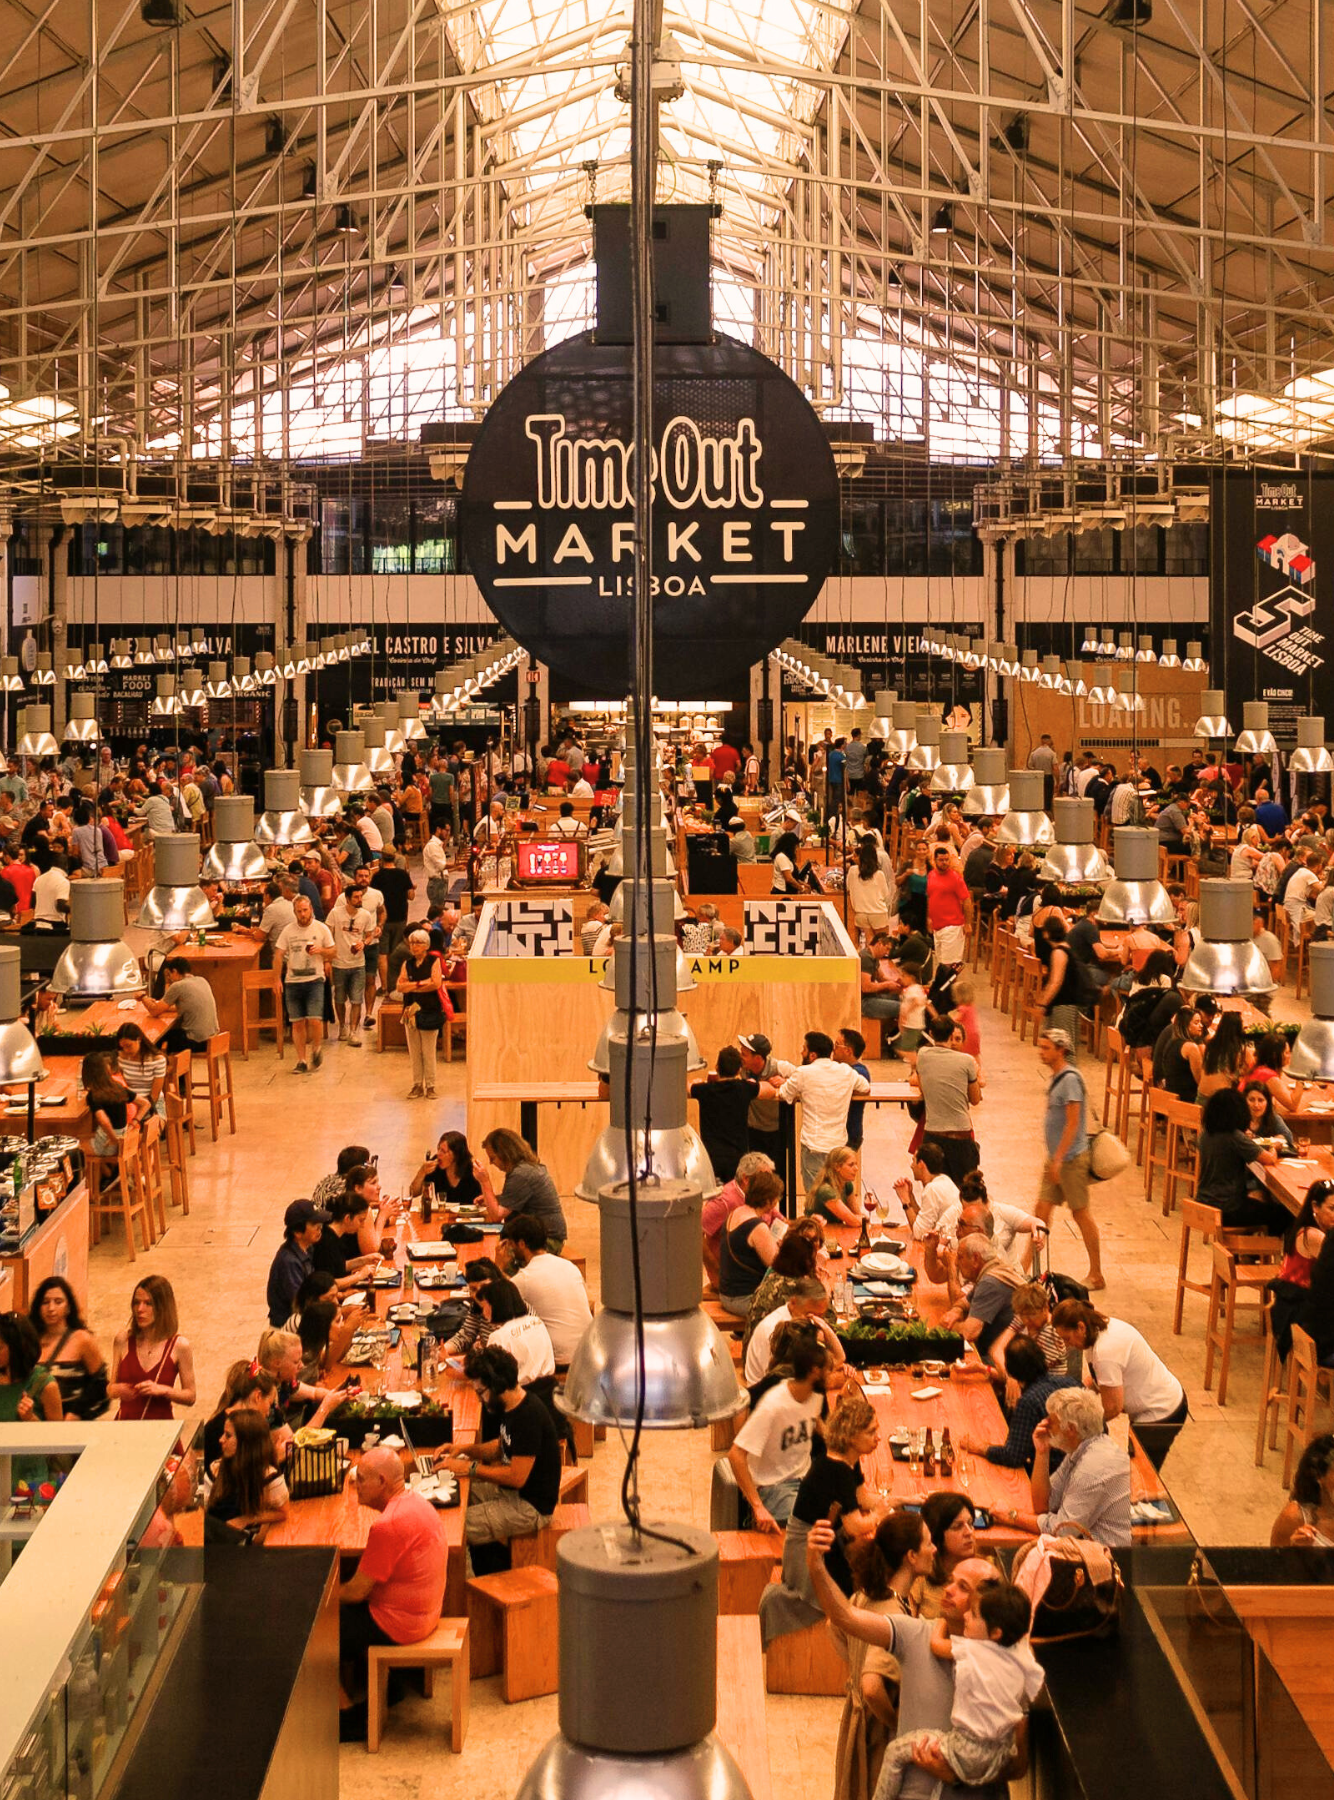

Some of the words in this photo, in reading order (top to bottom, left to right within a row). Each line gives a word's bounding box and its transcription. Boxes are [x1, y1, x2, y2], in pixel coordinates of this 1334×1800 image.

[660, 415, 764, 509] Out
[1255, 498, 1304, 506] MARKET
[496, 521, 805, 564] MARKET
[826, 635, 888, 653] MARLENE
[893, 635, 930, 653] VIEI
[1288, 631, 1313, 647] OUT
[1298, 625, 1326, 644] TIME
[385, 636, 437, 654] CASTRO
[444, 636, 450, 654] E
[1276, 637, 1325, 669] MARKET
[1262, 644, 1308, 676] LISBOA
[122, 681, 152, 690] FOOD
[780, 1417, 817, 1452] GA
